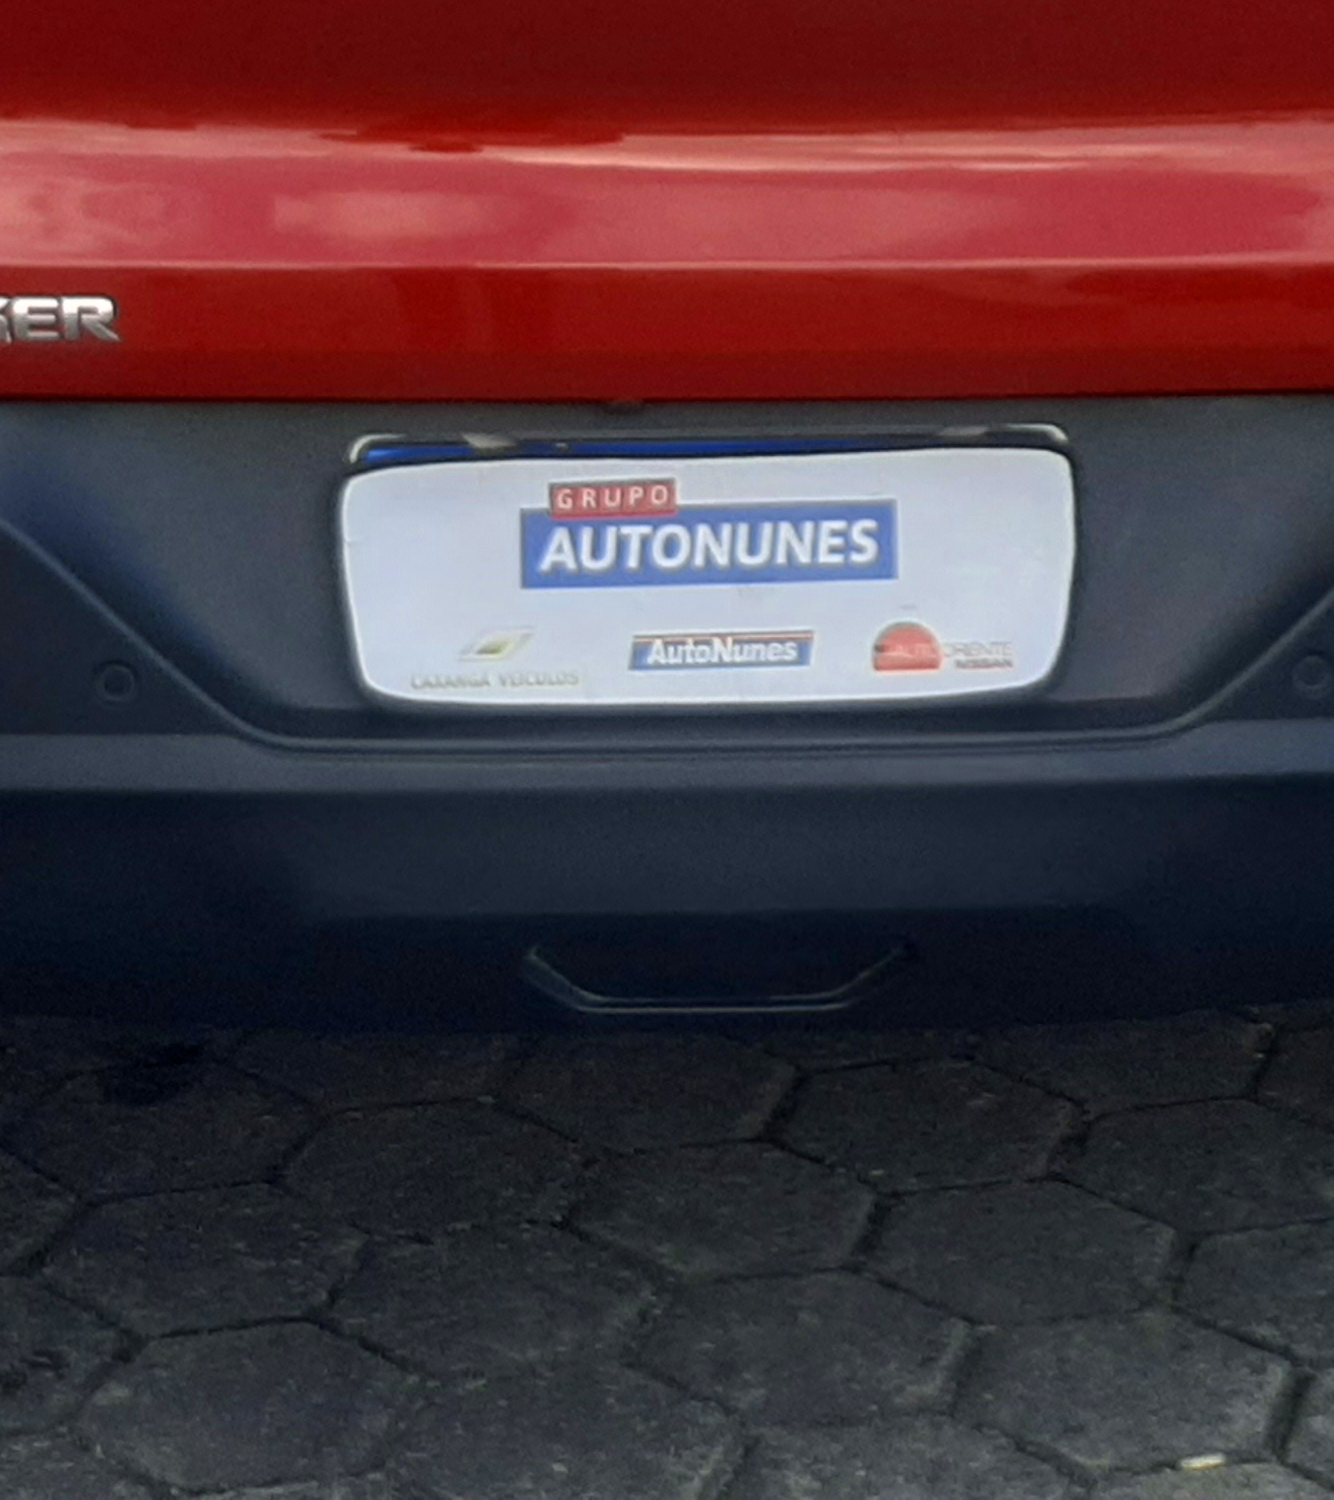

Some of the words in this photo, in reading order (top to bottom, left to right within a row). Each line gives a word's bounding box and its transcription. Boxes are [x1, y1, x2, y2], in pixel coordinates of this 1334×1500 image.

[556, 484, 669, 510] GRUPO
[539, 518, 879, 572] AUTONUNES
[647, 637, 799, 665] AutoNunes
